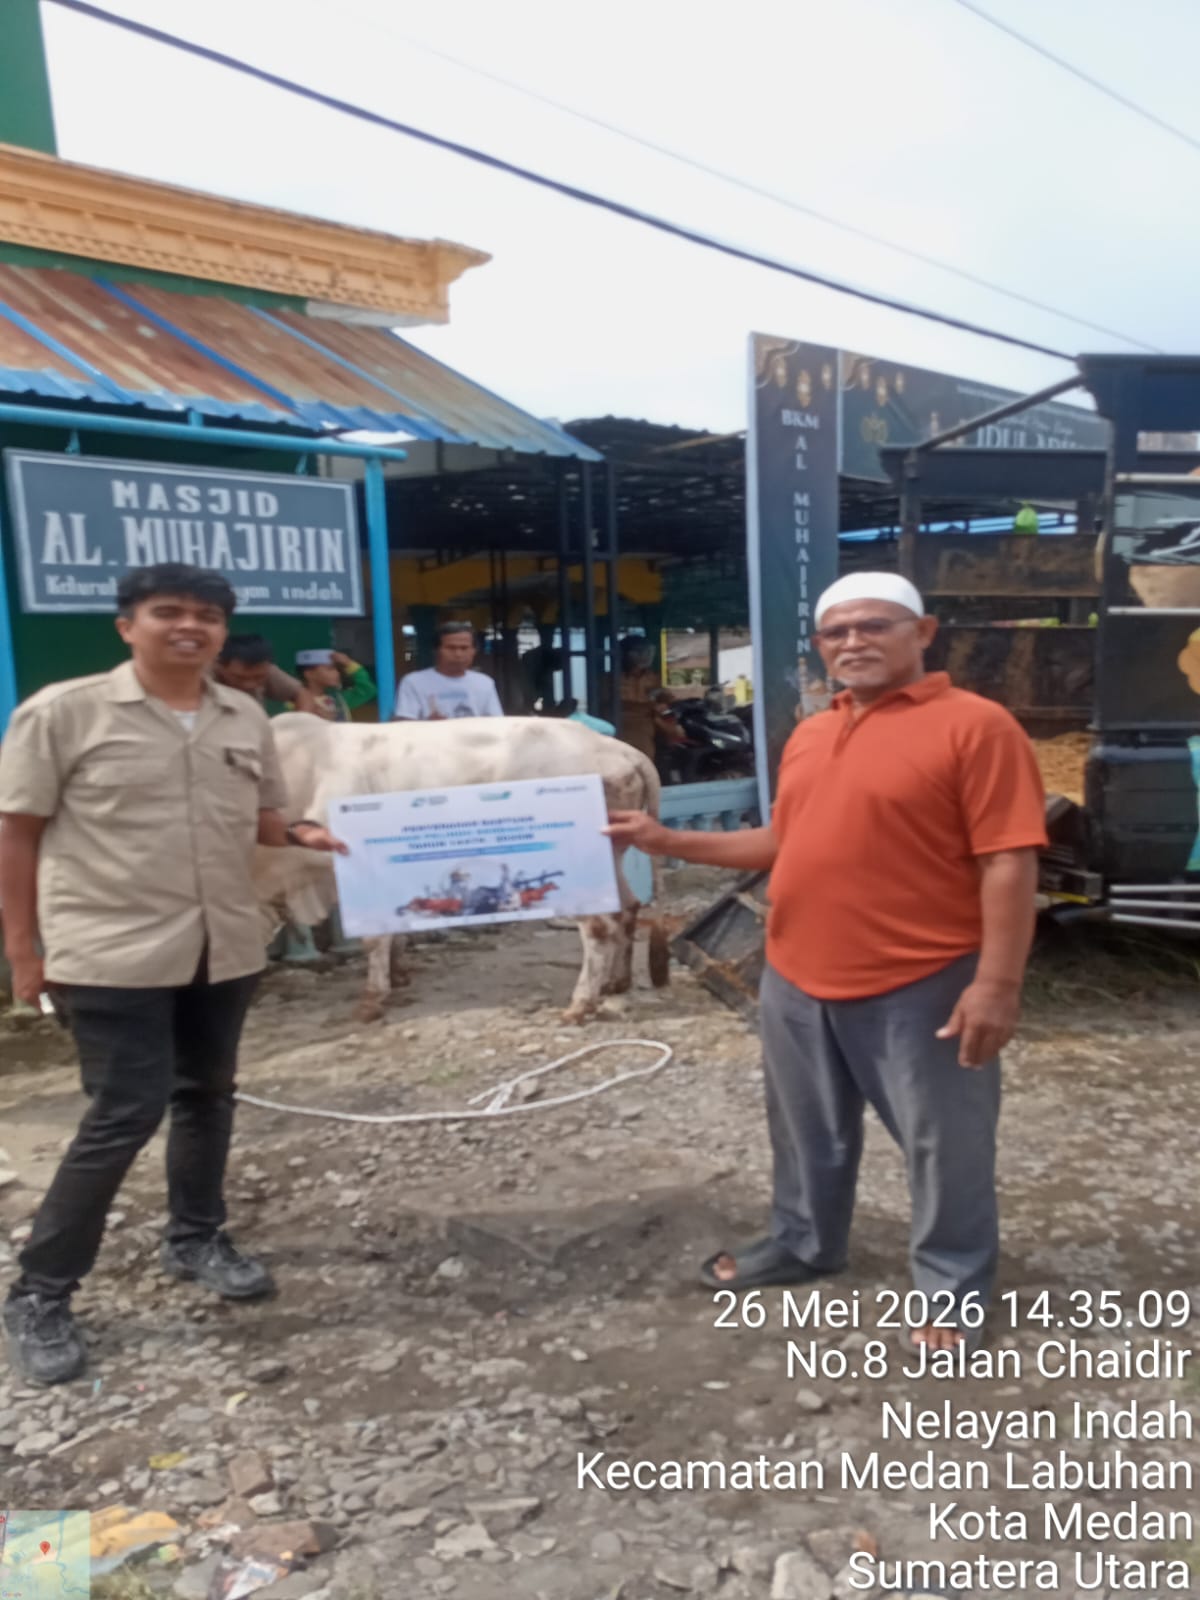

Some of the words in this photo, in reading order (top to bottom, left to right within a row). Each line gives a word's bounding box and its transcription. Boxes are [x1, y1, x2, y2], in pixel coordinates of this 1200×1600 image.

[781, 409, 820, 430] BKM
[111, 480, 280, 517] MASJID
[120, 516, 346, 573] MUHAJIRIN
